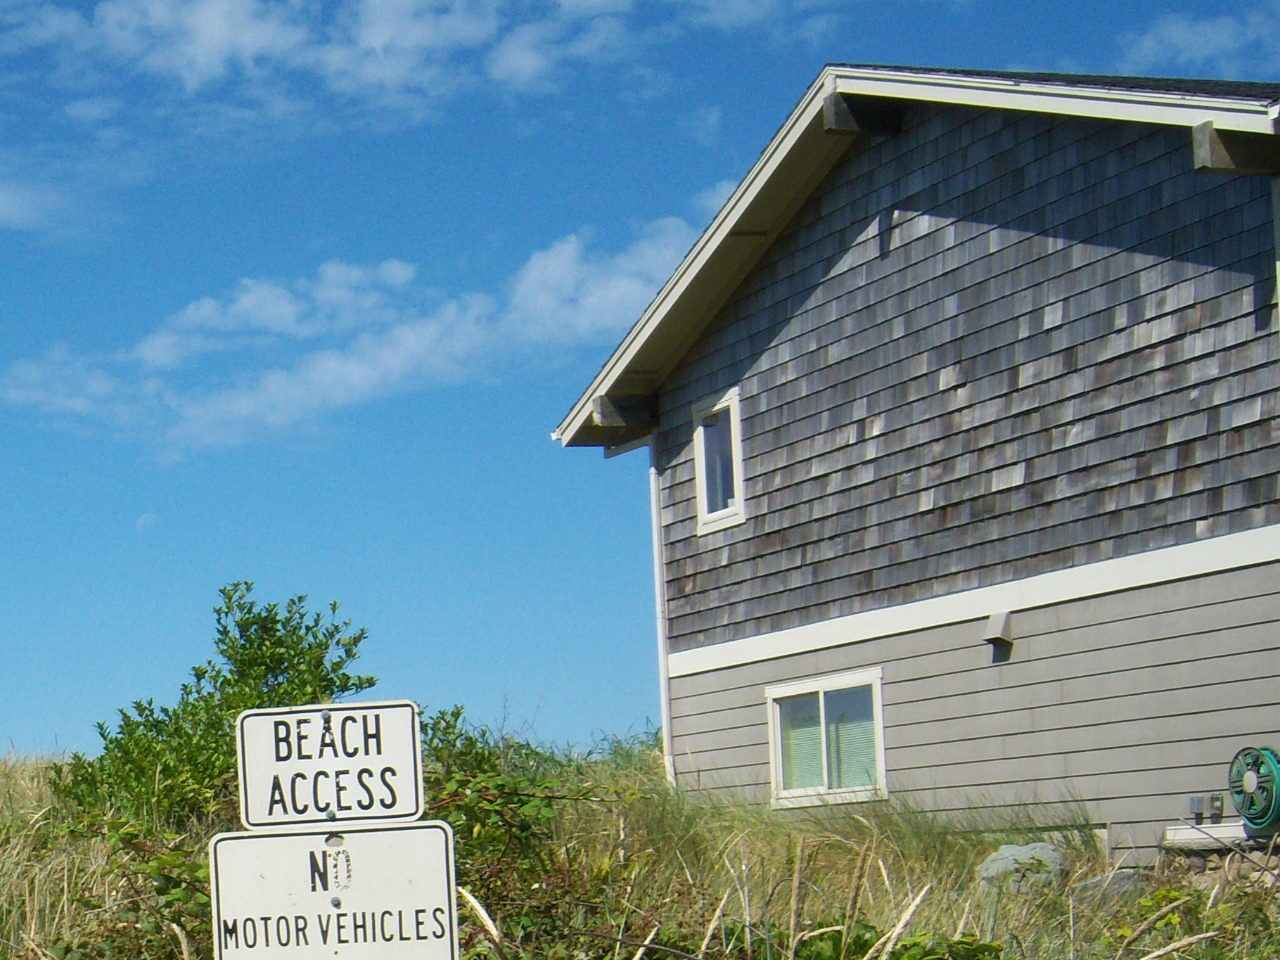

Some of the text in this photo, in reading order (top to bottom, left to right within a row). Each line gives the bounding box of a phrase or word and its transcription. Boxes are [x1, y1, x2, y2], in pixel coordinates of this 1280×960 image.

[273, 714, 382, 762] BEACH
[267, 766, 397, 816] ACCESS
[223, 907, 446, 950] MOTOR VEHICLES
